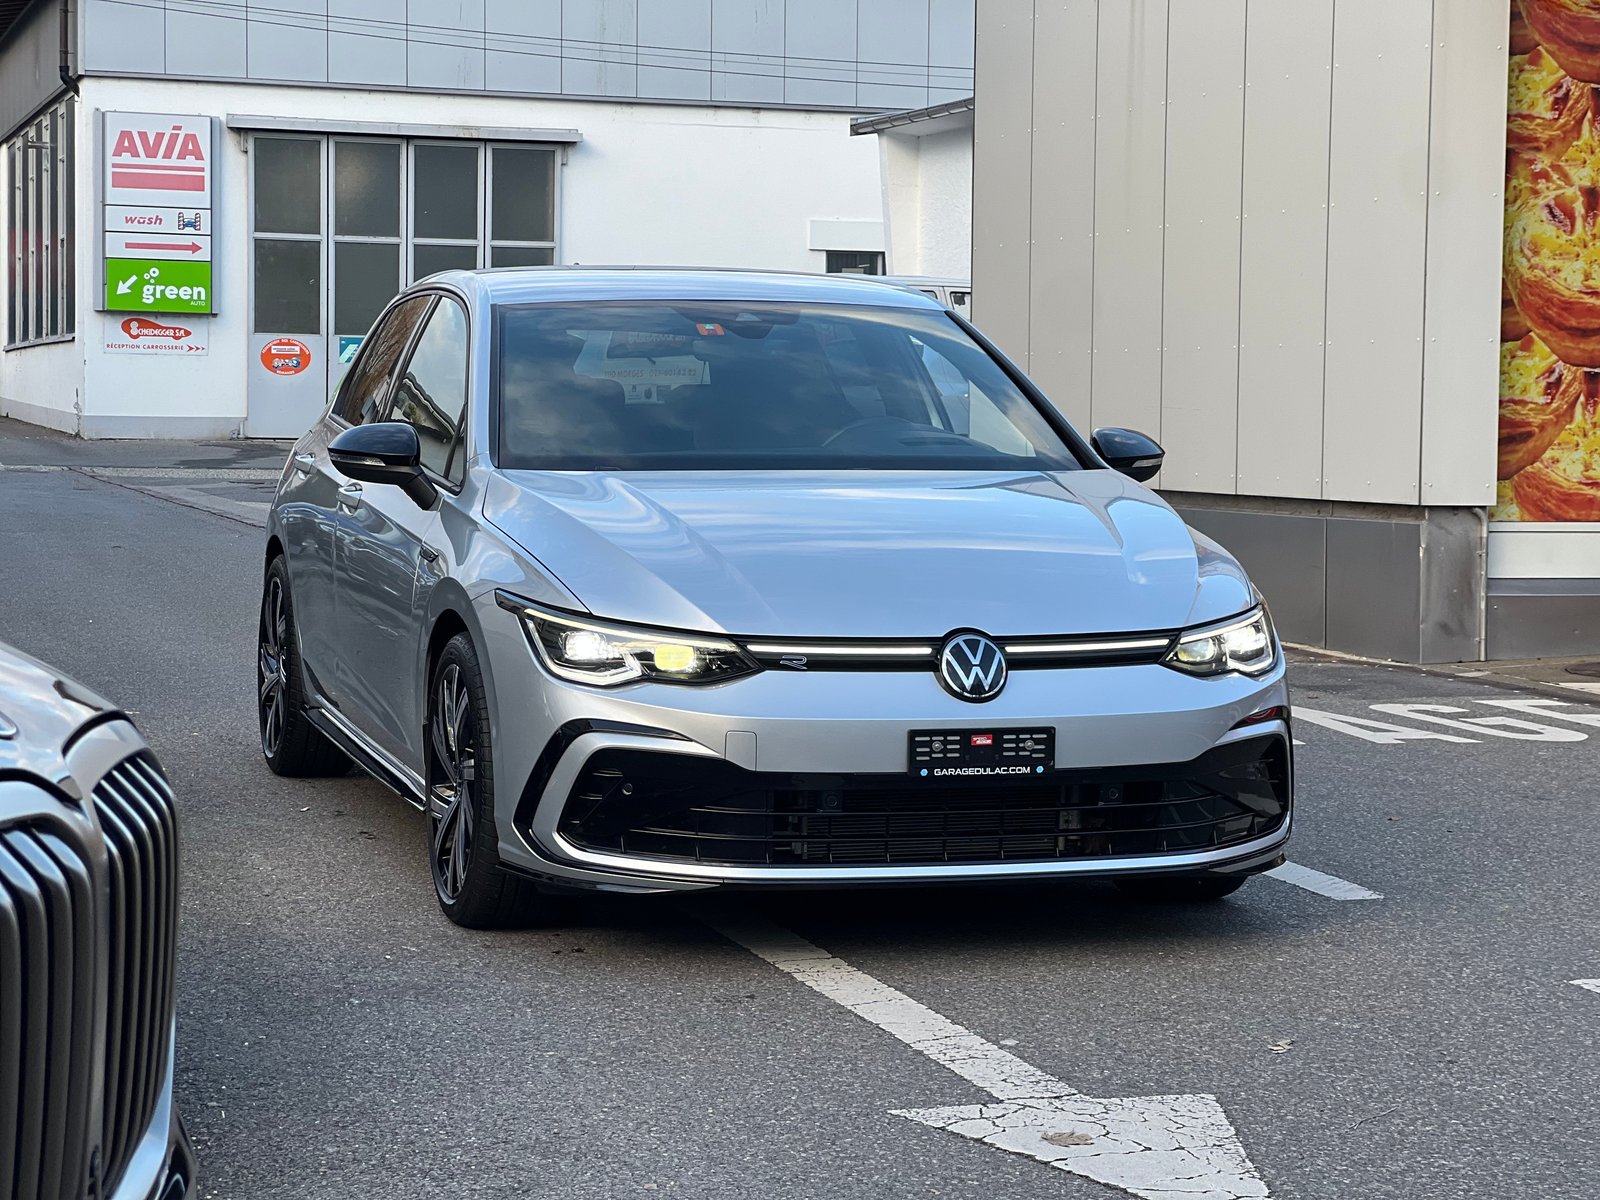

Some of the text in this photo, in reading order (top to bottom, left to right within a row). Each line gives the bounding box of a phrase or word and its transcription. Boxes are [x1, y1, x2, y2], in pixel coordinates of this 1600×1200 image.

[112, 125, 205, 161] AVIA
[124, 215, 163, 226] wash
[141, 284, 206, 304] green
[933, 766, 1031, 776] GARAGEDULAC.COM
